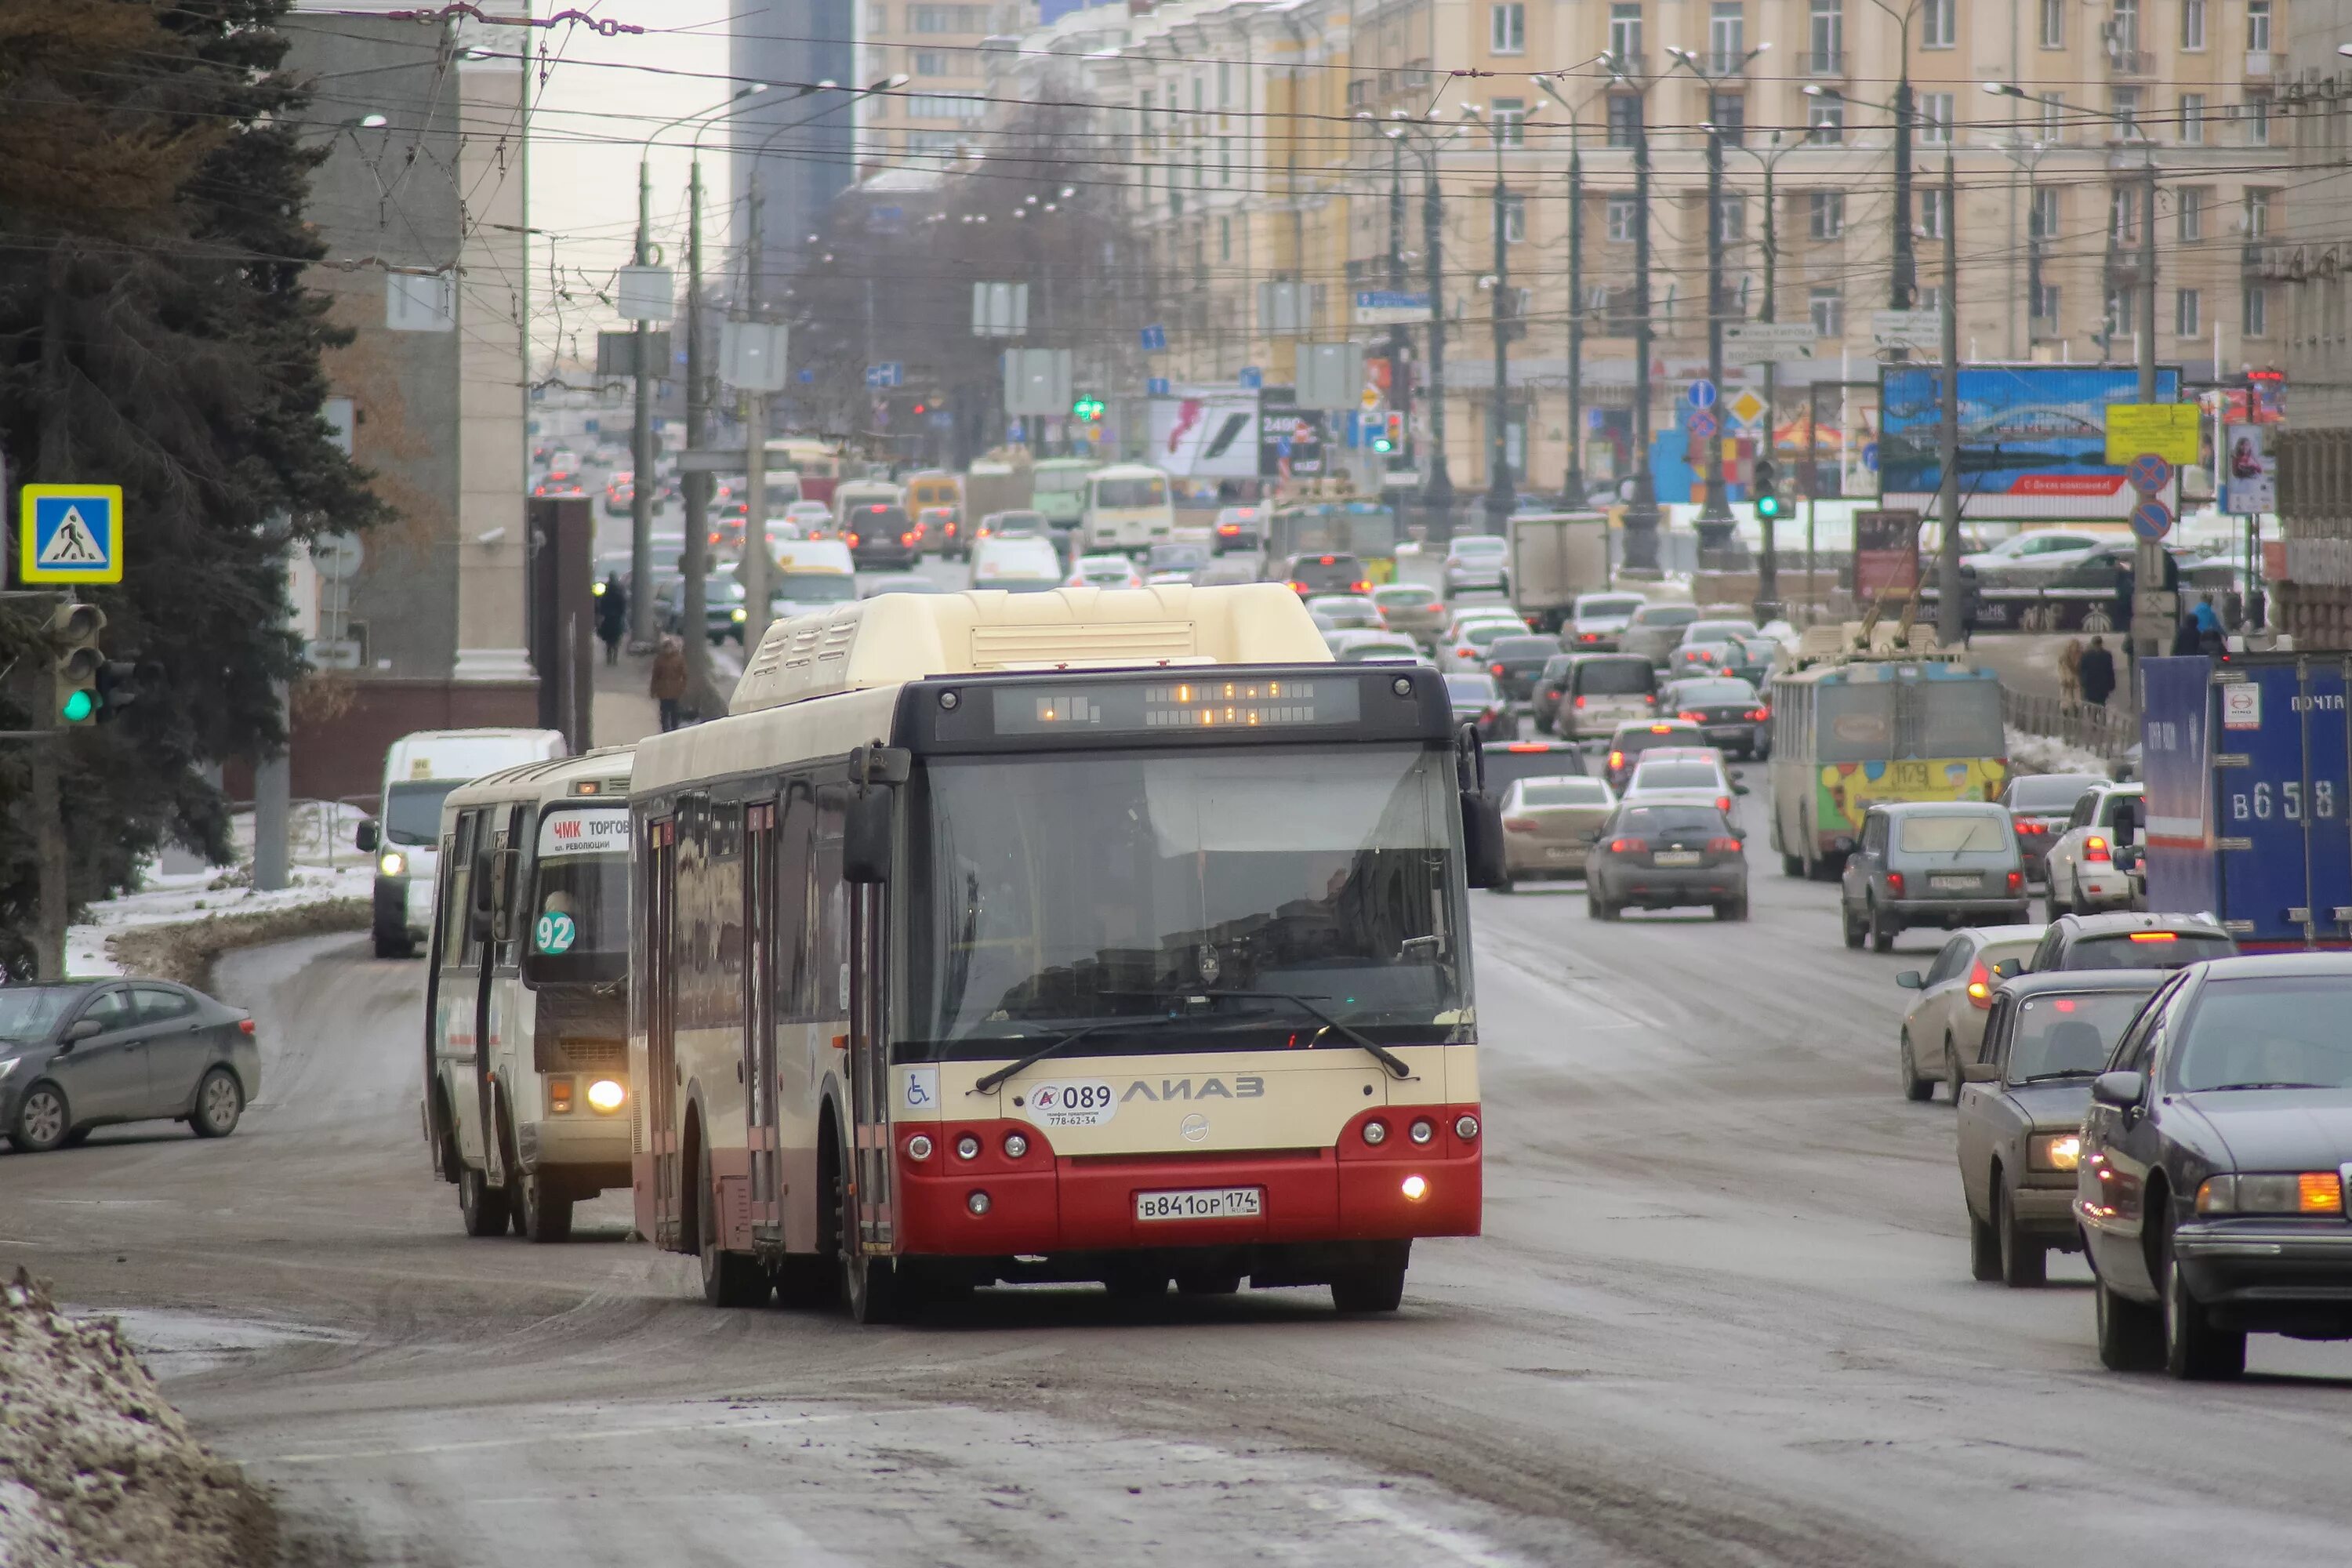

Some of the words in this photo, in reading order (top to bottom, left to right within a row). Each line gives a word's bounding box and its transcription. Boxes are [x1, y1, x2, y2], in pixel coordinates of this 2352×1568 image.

[2291, 695, 2346, 710] ПОЧТА
[554, 820, 582, 839] ЧМК
[565, 840, 610, 851] РЕВОЛЮЦИИ
[539, 916, 570, 949] 92
[1063, 1085, 1111, 1109] 089
[1120, 1076, 1265, 1103] ЛИАЗ
[1050, 1116, 1096, 1126] 778-62-34
[1145, 1194, 1221, 1217] В841ОР
[1225, 1191, 1254, 1207] 174
